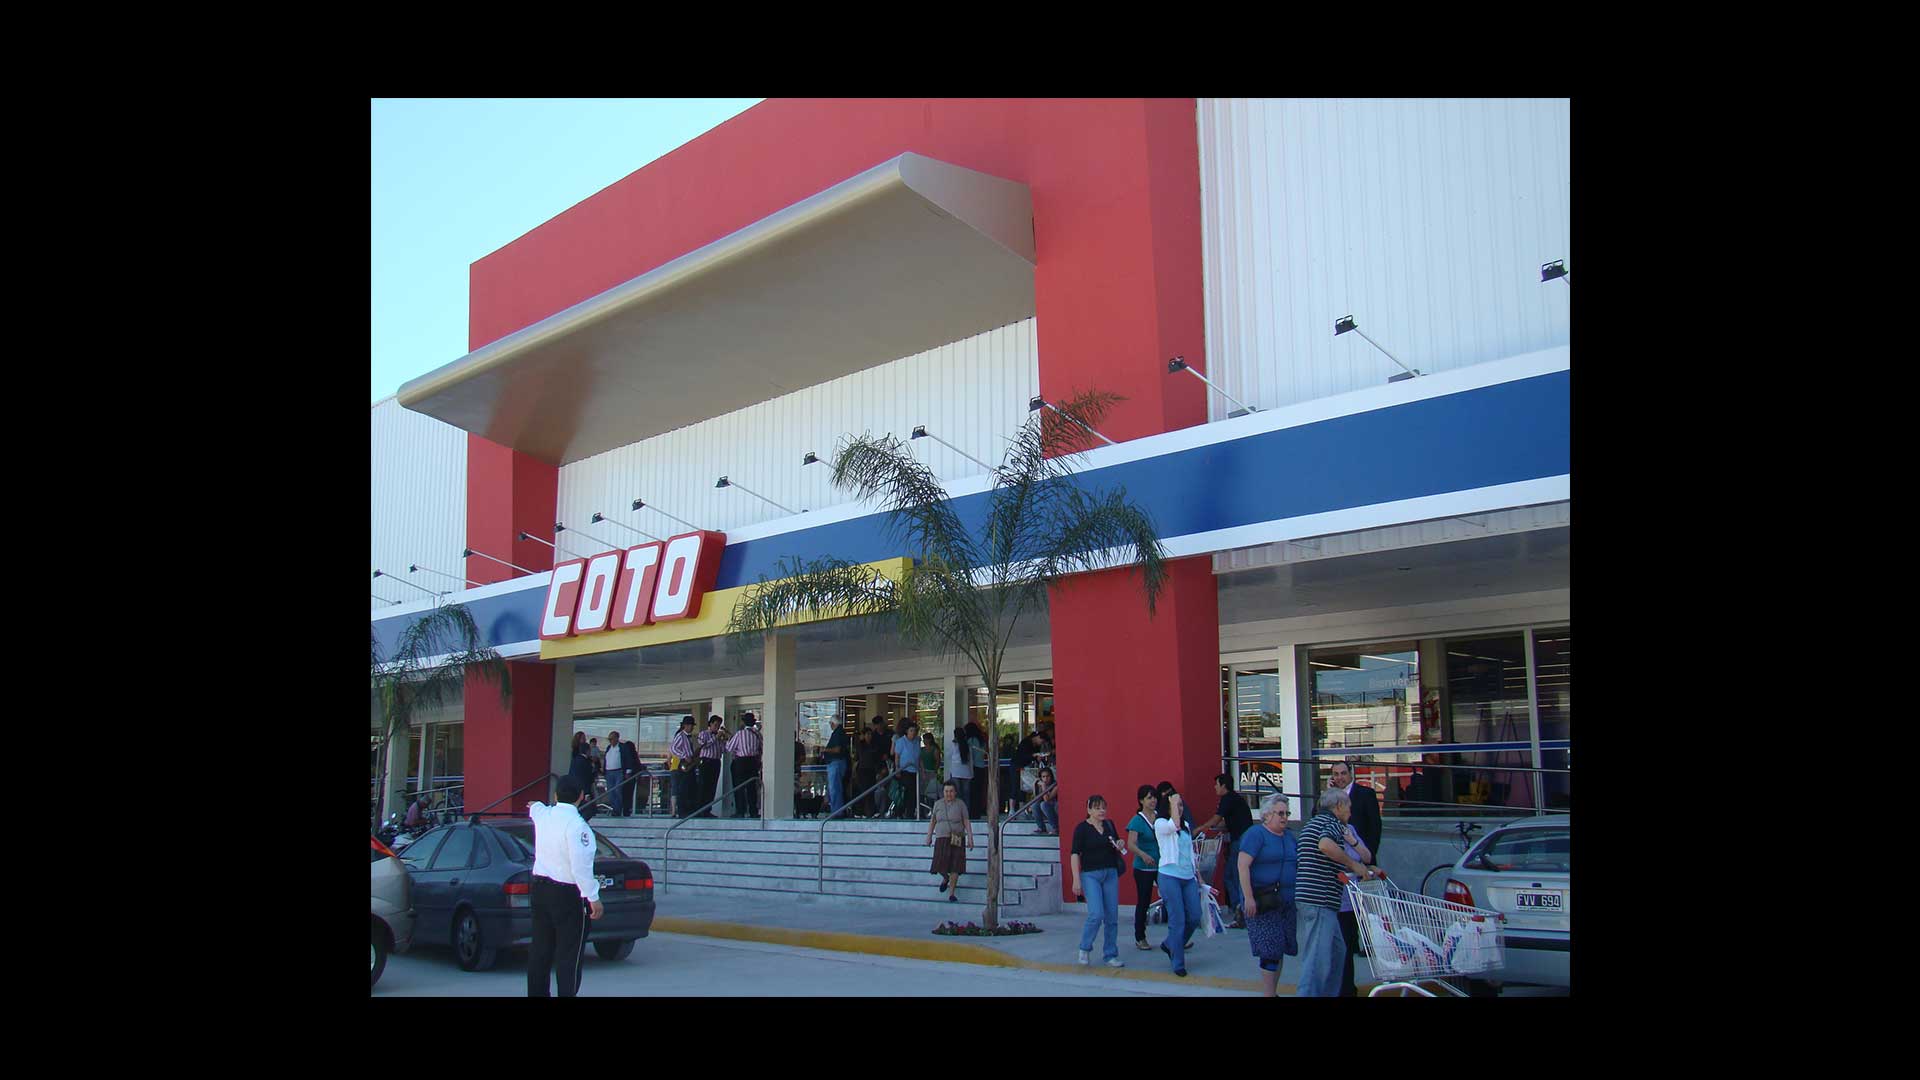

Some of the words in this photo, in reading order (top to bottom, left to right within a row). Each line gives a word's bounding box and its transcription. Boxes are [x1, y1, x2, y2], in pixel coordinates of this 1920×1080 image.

[542, 535, 701, 636] COTO
[1517, 894, 1536, 906] FVV
[1541, 895, 1560, 907] 694
